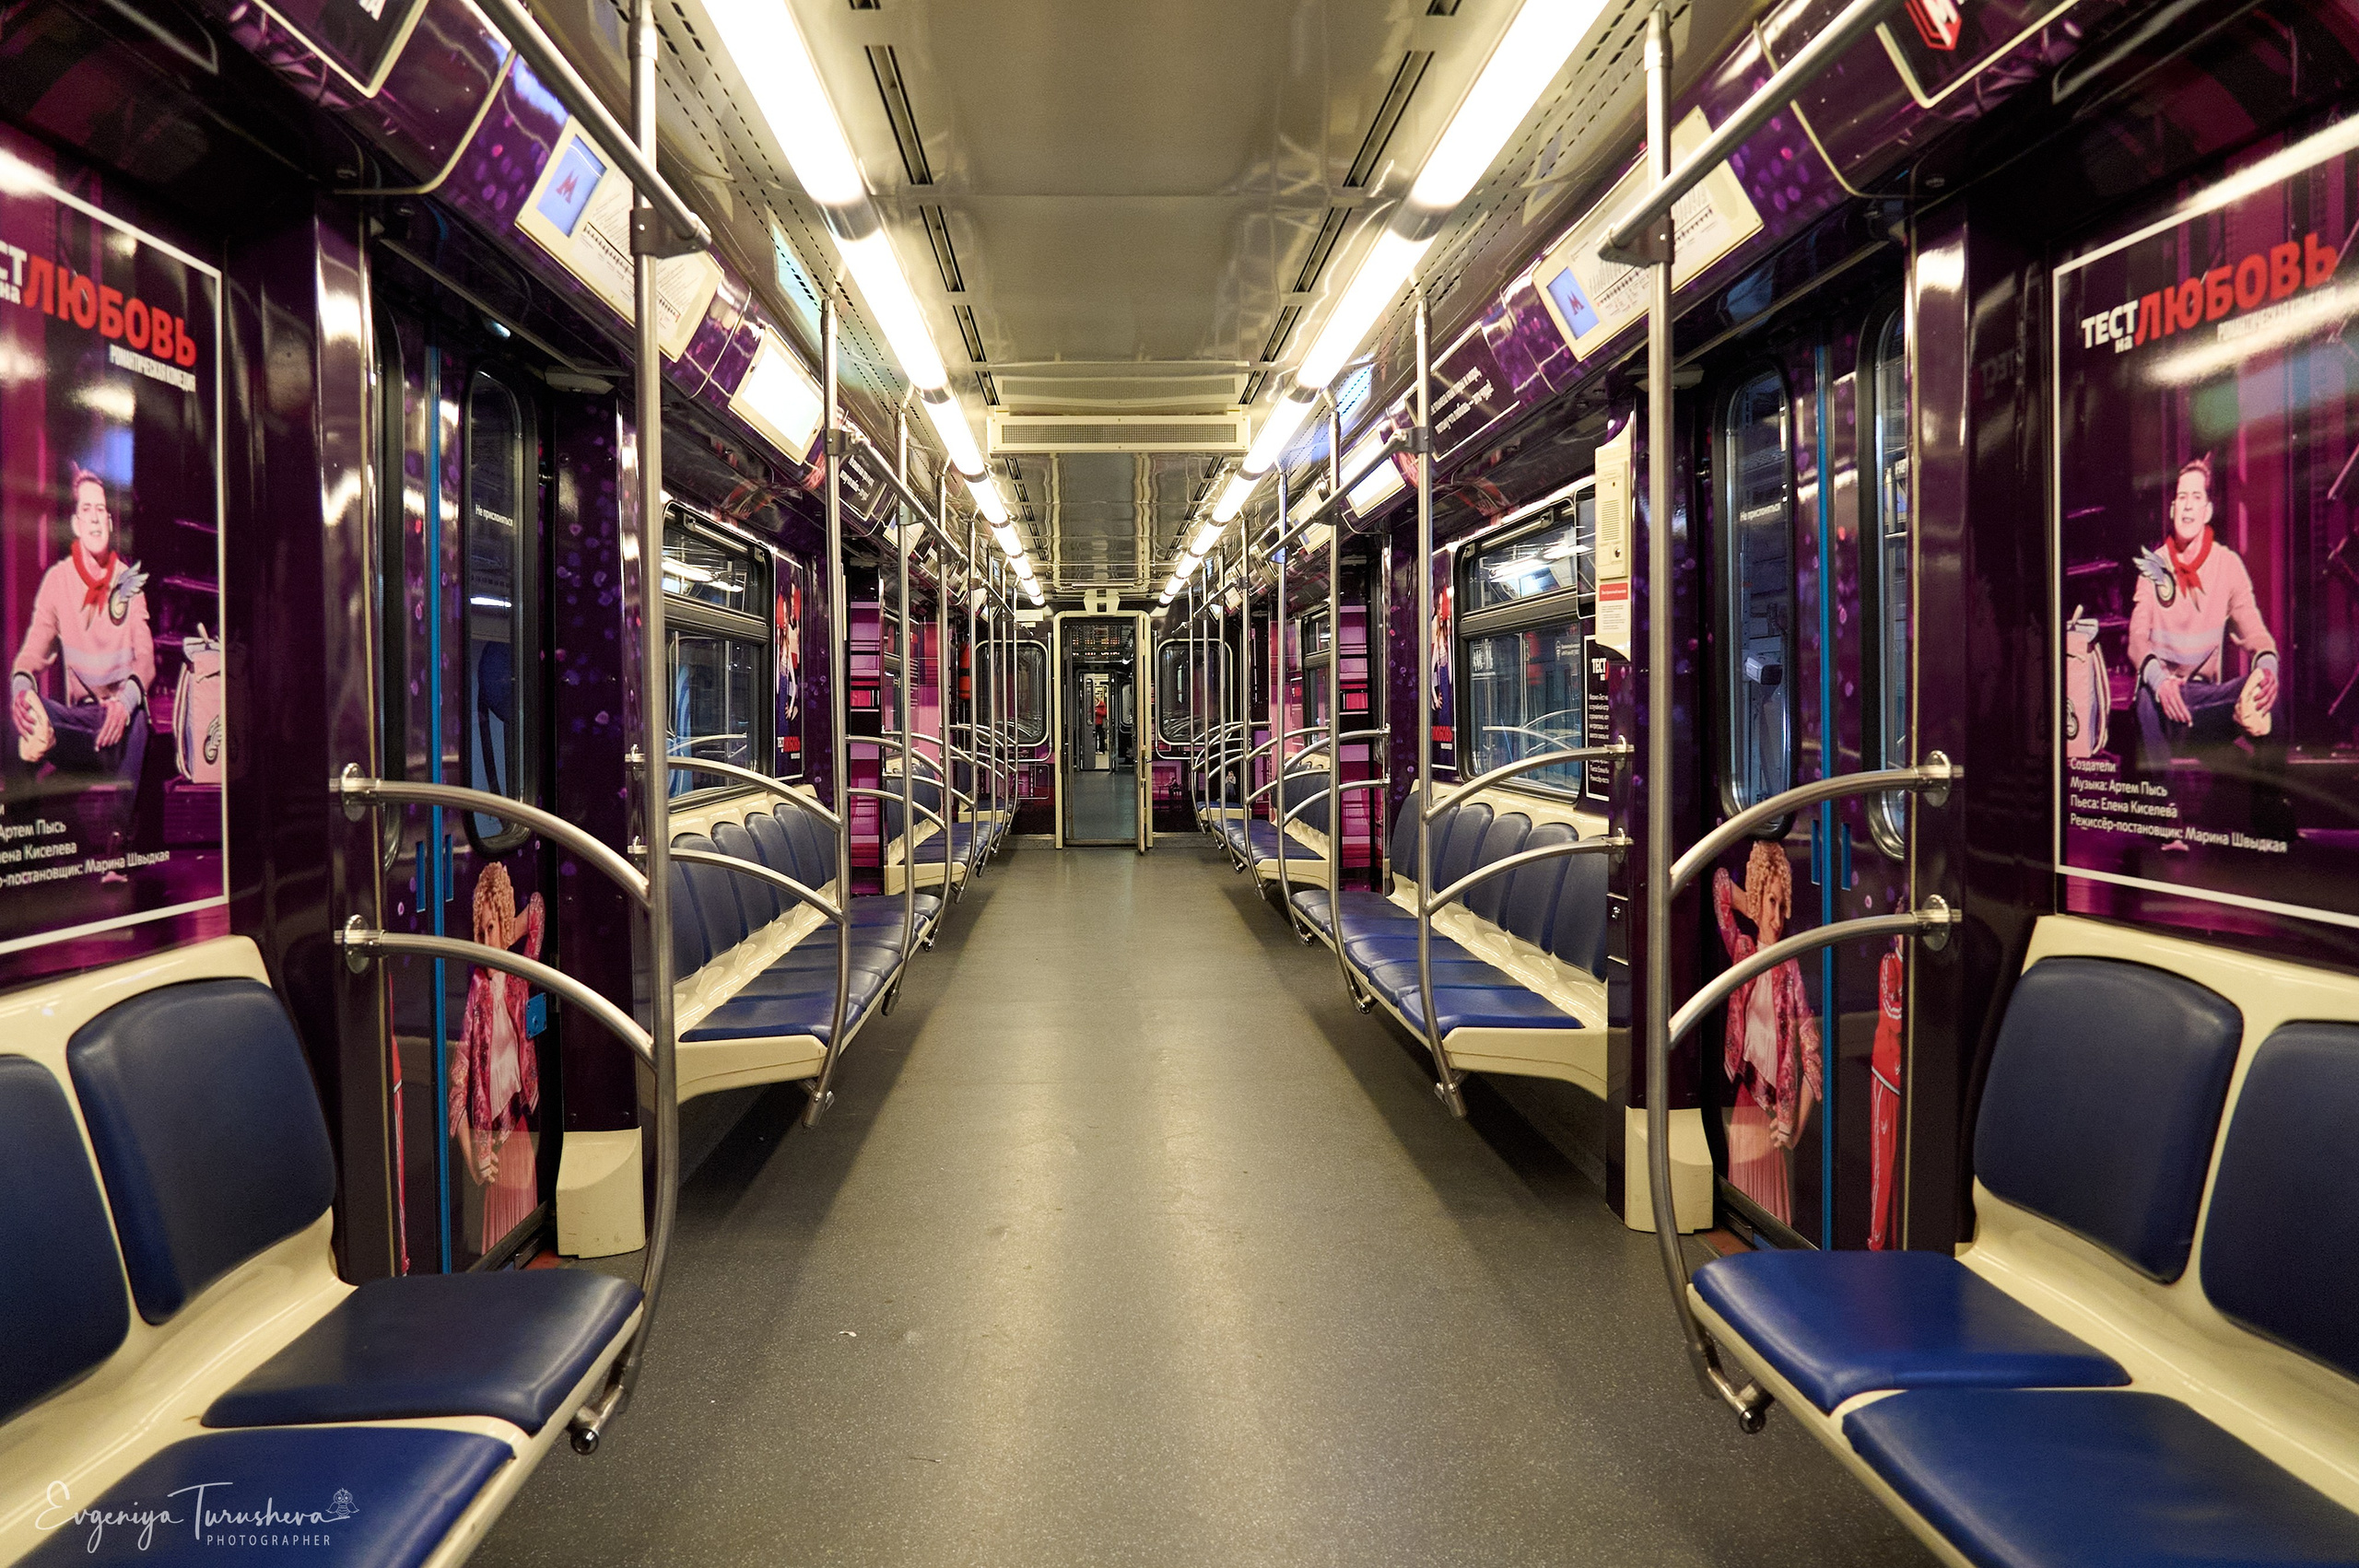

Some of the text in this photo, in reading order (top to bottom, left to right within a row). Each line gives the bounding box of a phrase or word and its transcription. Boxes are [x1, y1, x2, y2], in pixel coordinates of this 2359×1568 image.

[2081, 232, 2338, 349] ТЕСТ ЛЮБОВЬ
[24, 254, 197, 368] ЛЮБОВЬ
[2115, 334, 2133, 354] на
[2070, 756, 2117, 773] Создатели
[2070, 776, 2168, 797] Музыка: Артем Пысь
[2070, 794, 2178, 819] Пьеса: Елена Киселева
[36, 818, 67, 836] Пысь
[2185, 825, 2230, 846] Марина
[2231, 831, 2288, 853] Швыдкая
[23, 841, 77, 860] Киселева
[84, 857, 126, 874] Марина
[126, 850, 170, 868] Швыдкая
